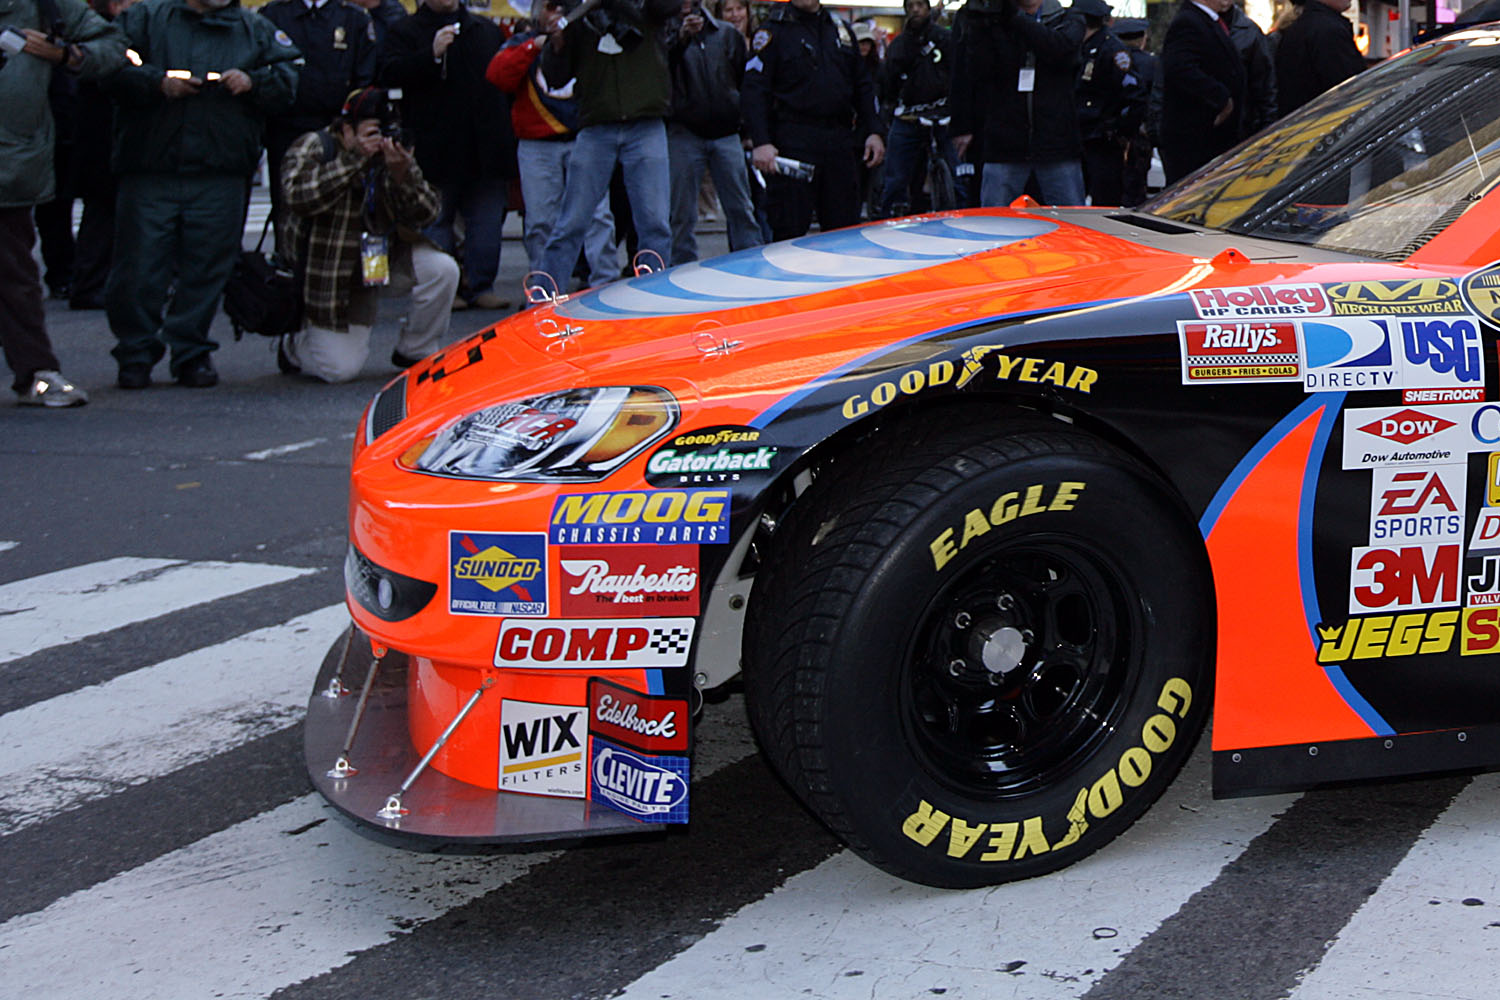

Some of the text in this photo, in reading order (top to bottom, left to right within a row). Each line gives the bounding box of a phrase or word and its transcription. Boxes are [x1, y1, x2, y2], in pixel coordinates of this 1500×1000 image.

[1193, 286, 1325, 313] Holley
[1202, 306, 1306, 317] HP CARBS
[1418, 300, 1465, 313] WEAR
[1202, 323, 1278, 353] Rally's
[1400, 319, 1480, 383] USG
[1194, 366, 1293, 377] BURGERS FRIES COLAS
[1306, 371, 1394, 388] DIRECTV
[1404, 389, 1480, 402] SHEETROCK
[648, 447, 776, 475] Gatorback
[1361, 453, 1390, 463] Dow
[1390, 450, 1452, 462] Automotive
[679, 473, 741, 484] BELTS
[1377, 471, 1459, 517] EA
[551, 490, 729, 526] MOOG
[558, 525, 718, 544] CHASSIS PARTS
[928, 481, 1087, 573] EAGLE
[1374, 515, 1461, 539] SPORTS
[457, 559, 541, 579] SUNOCO
[560, 559, 699, 603] Raybestos
[1353, 544, 1461, 609] 3M
[480, 601, 497, 610] FUEL
[510, 602, 543, 614] NASCAR
[621, 593, 643, 604] best
[499, 627, 650, 662] COMP
[1317, 610, 1461, 663] JEGS
[596, 694, 677, 738] Edelbrock
[503, 712, 581, 760] WIX
[502, 764, 582, 786] FILTERS
[596, 748, 676, 804] CLEVITE
